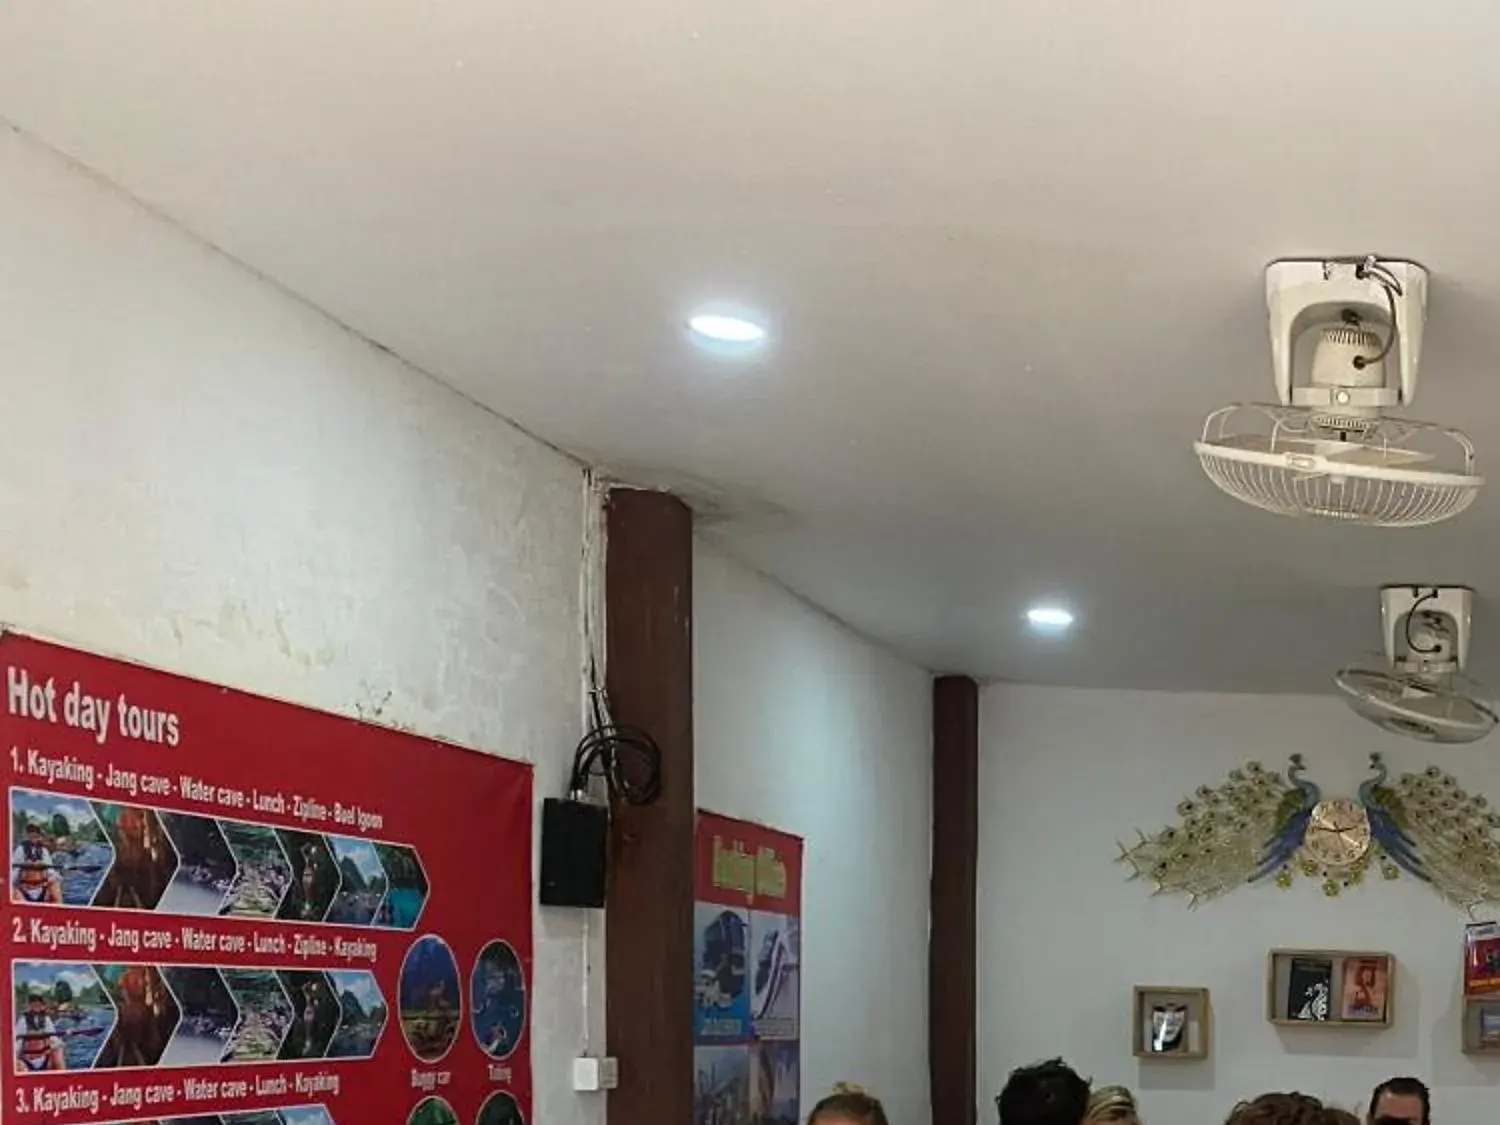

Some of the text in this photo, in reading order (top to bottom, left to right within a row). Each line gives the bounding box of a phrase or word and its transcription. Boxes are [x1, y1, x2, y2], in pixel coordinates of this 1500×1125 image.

[8, 666, 180, 746] Hot day tours
[10, 746, 24, 773] 1.
[28, 748, 95, 790] Kayaking
[106, 763, 138, 796] Jang
[140, 775, 172, 795] cave
[179, 775, 215, 802] Water
[217, 786, 244, 808] cave
[252, 788, 285, 814] Lunch
[12, 916, 27, 943] 2.
[30, 918, 97, 952] Kayaking
[107, 922, 140, 953] Jang
[142, 929, 173, 949] cave
[181, 927, 217, 951] Water
[219, 934, 246, 953] cave
[253, 931, 286, 954] Lunch
[334, 936, 377, 963] Kayaking
[15, 1071, 340, 1117] 3. Kayaking Jang cave Water cave Lunch Kayaking
